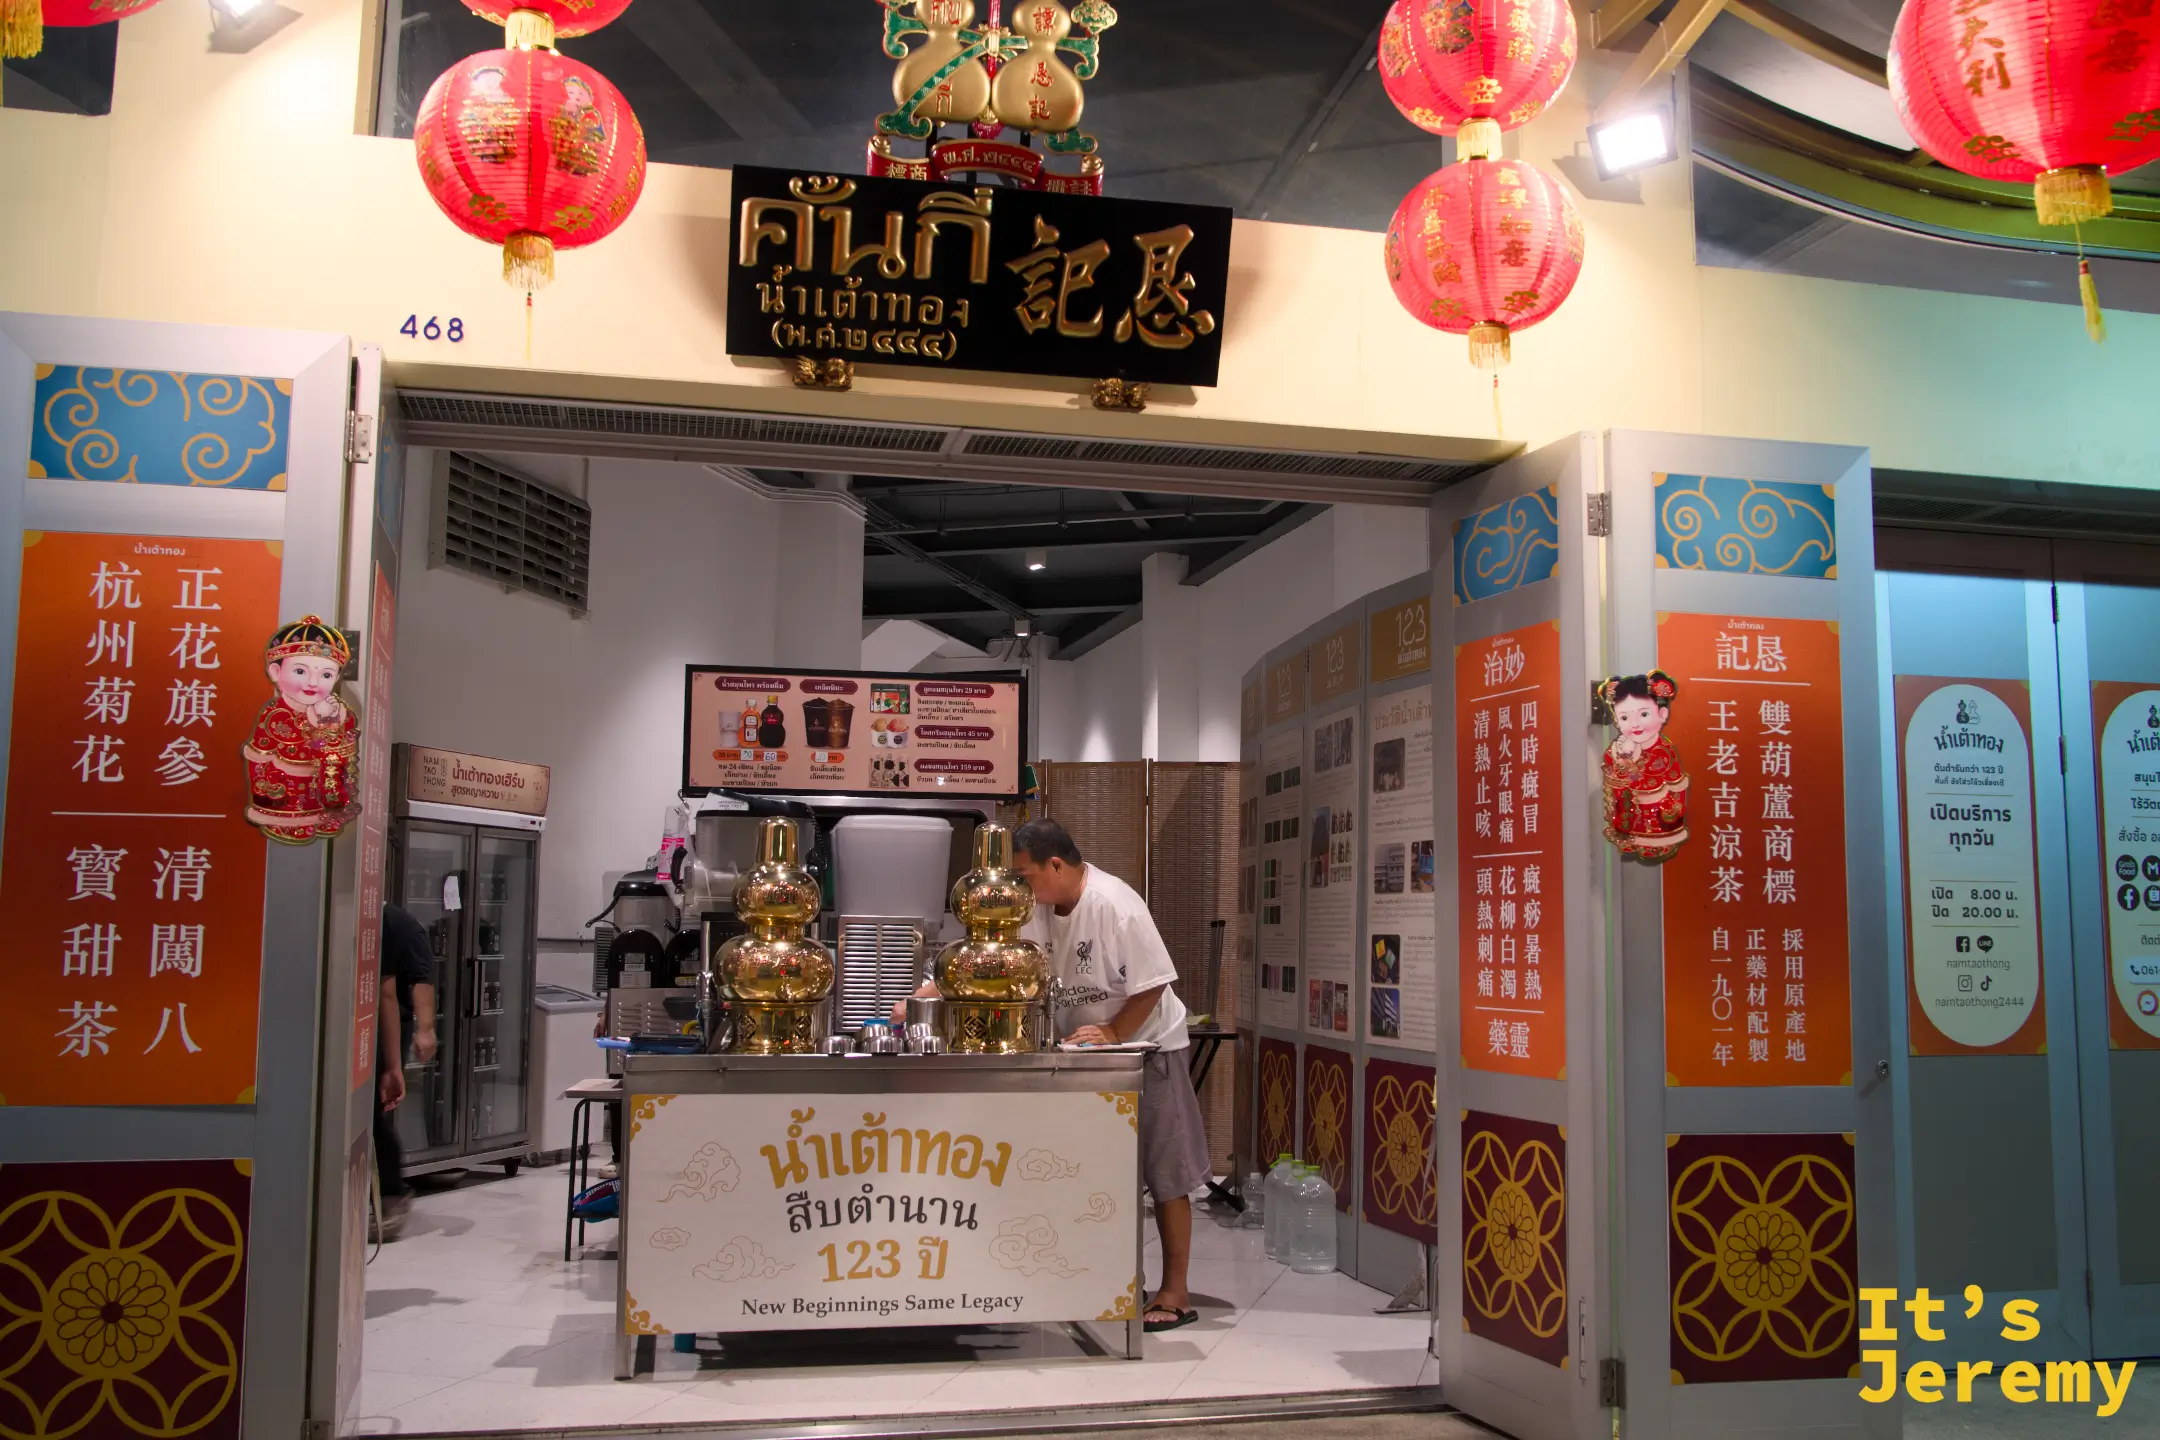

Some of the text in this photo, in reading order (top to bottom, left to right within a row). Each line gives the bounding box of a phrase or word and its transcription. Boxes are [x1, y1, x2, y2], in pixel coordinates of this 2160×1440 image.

[756, 264, 969, 327] น้ำเต้าทอง
[400, 314, 464, 342] 468
[1396, 604, 1426, 647] 123
[72, 561, 142, 784] 杭州菊花
[154, 566, 223, 786] 正花旗參
[423, 755, 440, 766] NAM
[1934, 725, 2004, 753] น้ำเต้าทอง
[423, 766, 437, 775] TAO
[423, 775, 446, 787] THONG
[1474, 710, 1492, 838] 清熱止咳
[1498, 706, 1514, 844] 風火牙眼痛
[1981, 766, 1996, 774] 123
[1707, 700, 1744, 903] 王老吉涼茶
[1758, 700, 1796, 904] 雙葫蘆商標
[1930, 802, 2012, 823] เปิดบริการ
[1949, 829, 1994, 852] ทุกวัน
[2119, 826, 2147, 843] สั่งซื้อ
[1931, 886, 2018, 901] เปิด 8.00 น.
[1932, 904, 2019, 920] ปิด 20.00 น.
[55, 843, 128, 1058] 寶甜茶
[1499, 865, 1516, 1000] 花柳白濁
[1946, 957, 2011, 971] namtaothong
[1746, 928, 1769, 1062] 正藥材配製
[1782, 928, 1806, 1062] 採用原產地
[1935, 996, 2024, 1009] namtaothong2444
[759, 1106, 1013, 1189] น้ำเต้าทอง
[786, 1183, 979, 1233] สืบตำนาน
[817, 1235, 948, 1282] 123 ปี
[741, 1292, 1024, 1319] New Beginnings Same Legacy
